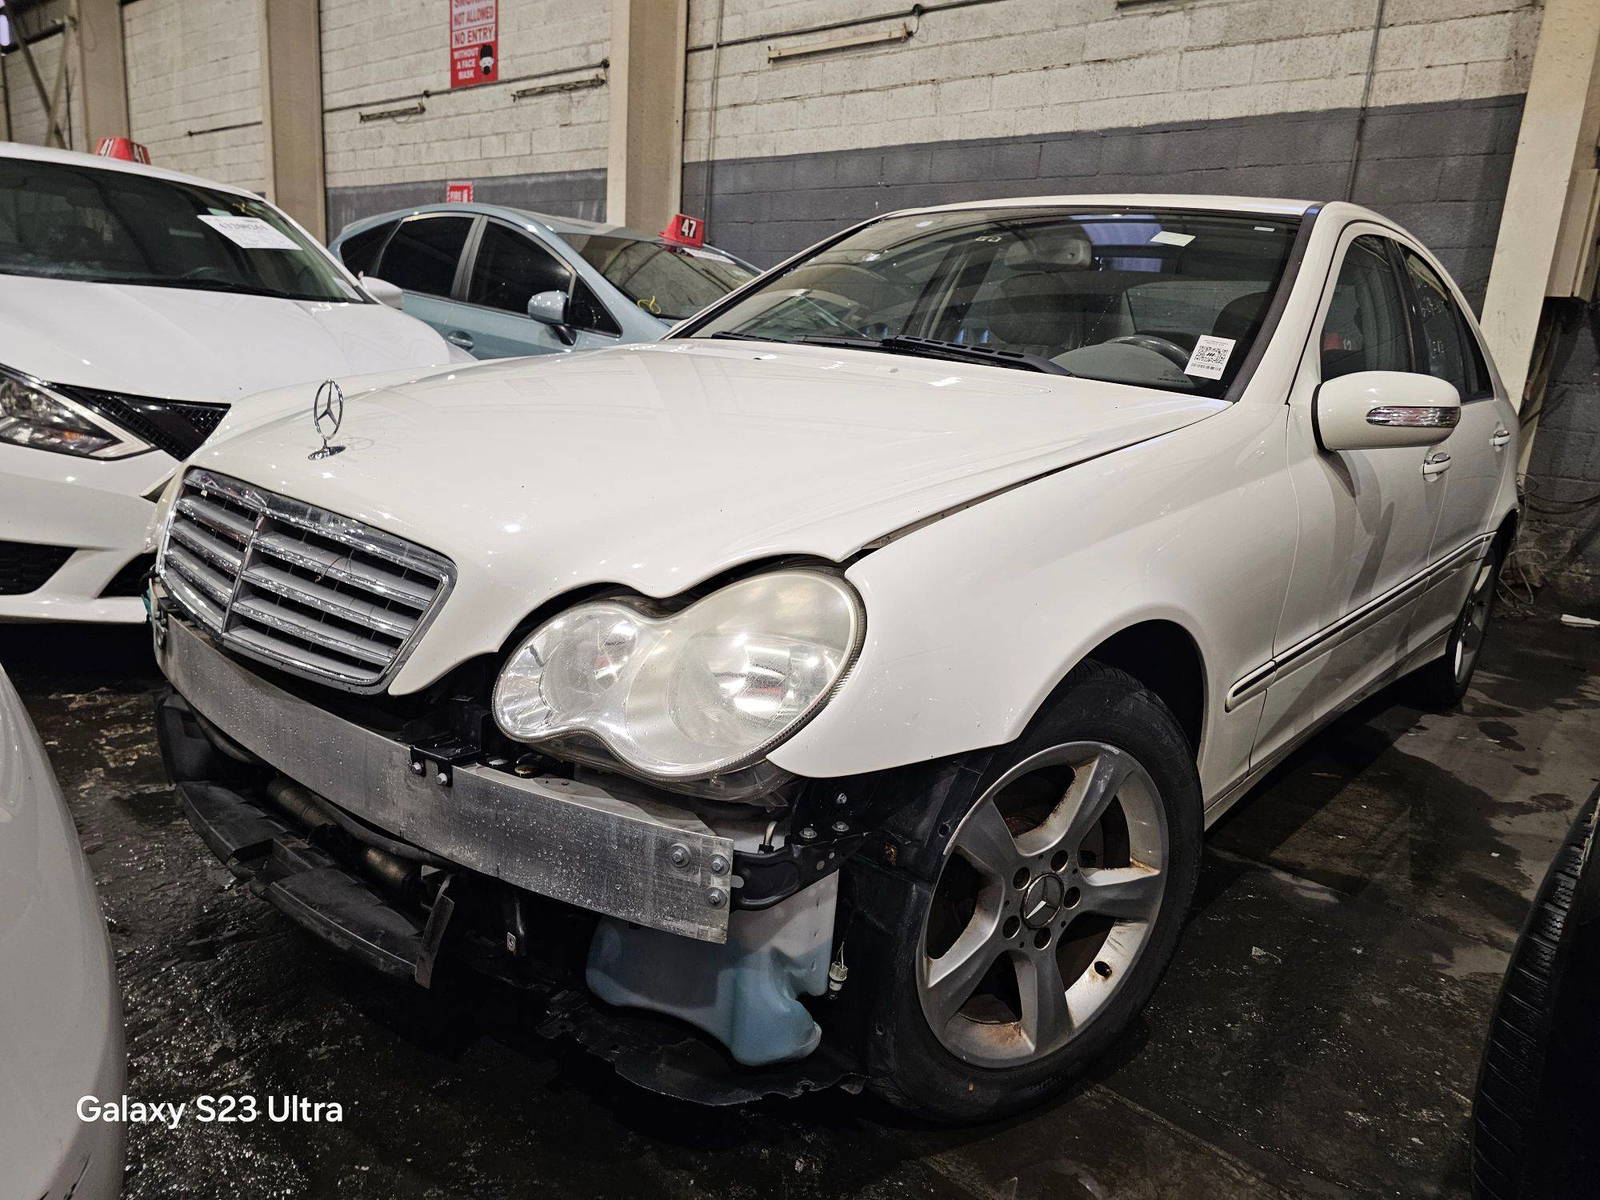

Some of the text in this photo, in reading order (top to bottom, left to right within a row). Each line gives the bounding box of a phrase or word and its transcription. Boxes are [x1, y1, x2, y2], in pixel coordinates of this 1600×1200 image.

[455, 26, 494, 45] NO ENTRY
[681, 218, 697, 238] 47
